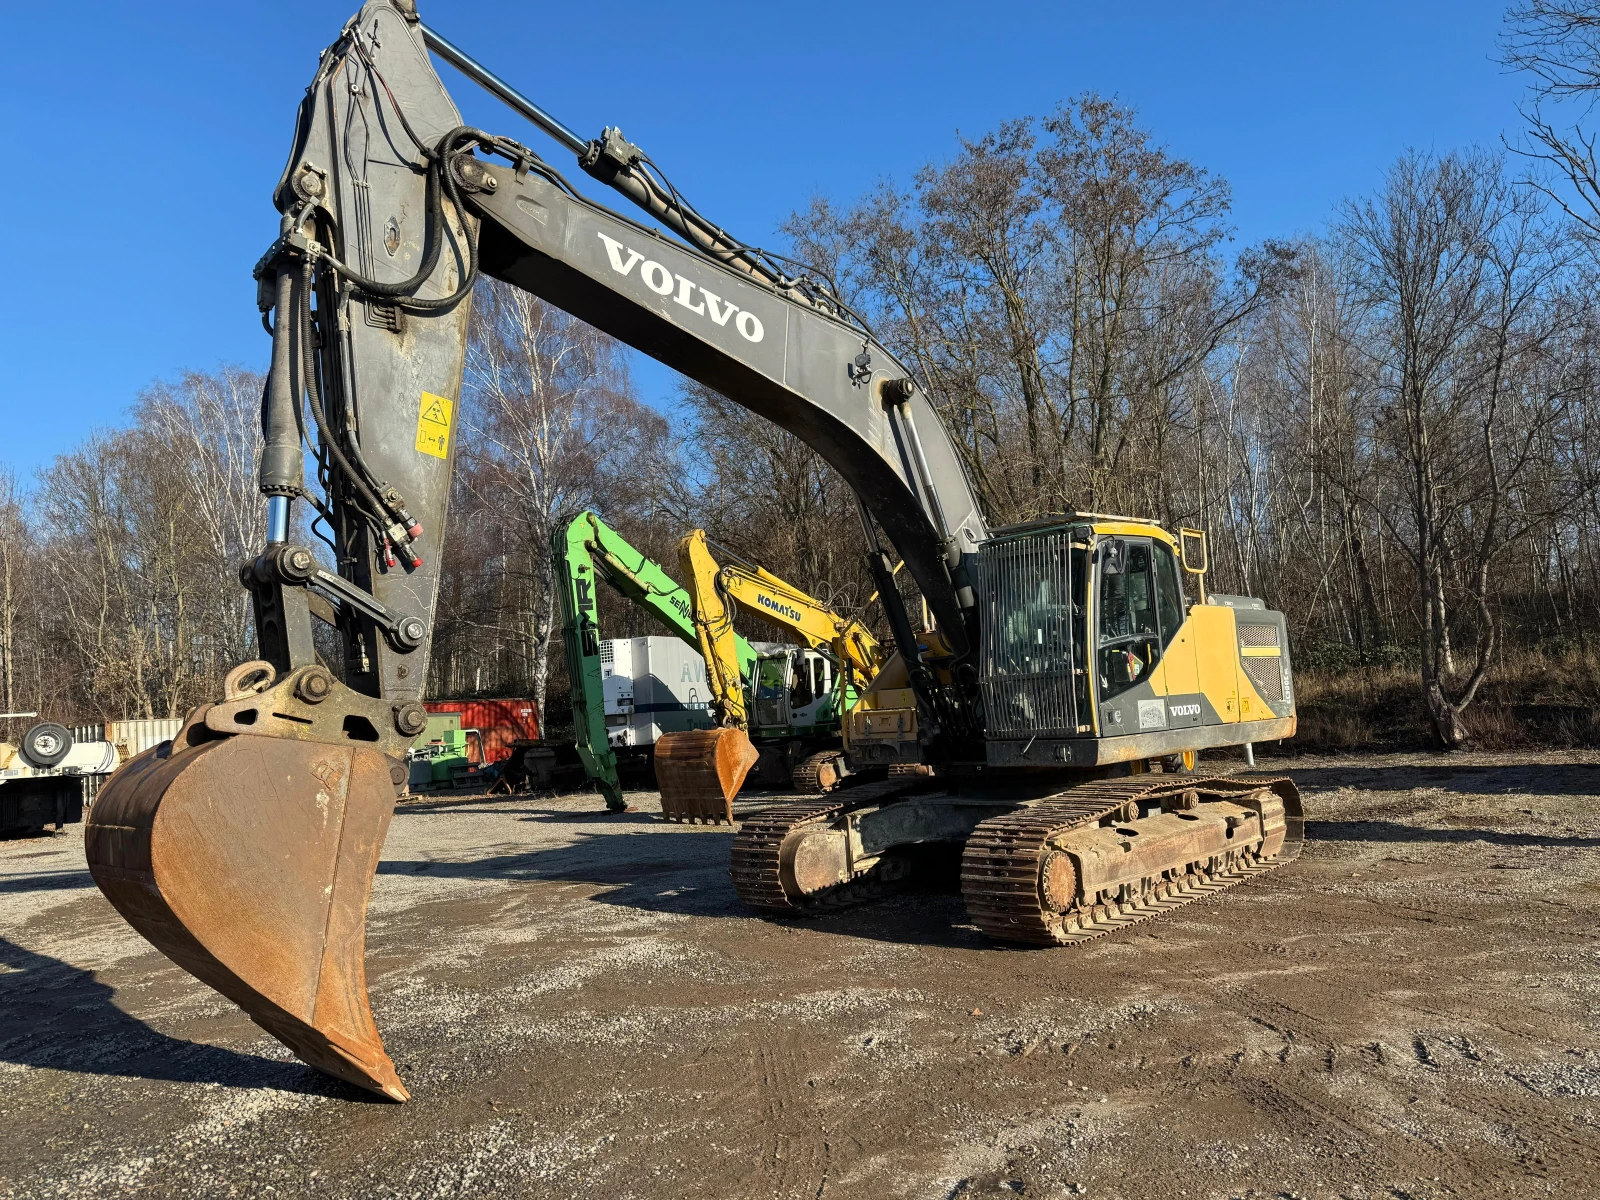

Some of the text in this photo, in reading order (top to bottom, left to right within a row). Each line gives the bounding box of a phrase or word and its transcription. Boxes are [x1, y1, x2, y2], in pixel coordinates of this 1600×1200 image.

[597, 232, 764, 343] VOLVO
[757, 593, 802, 622] KOMATSU
[1169, 703, 1201, 717] VOLVO
